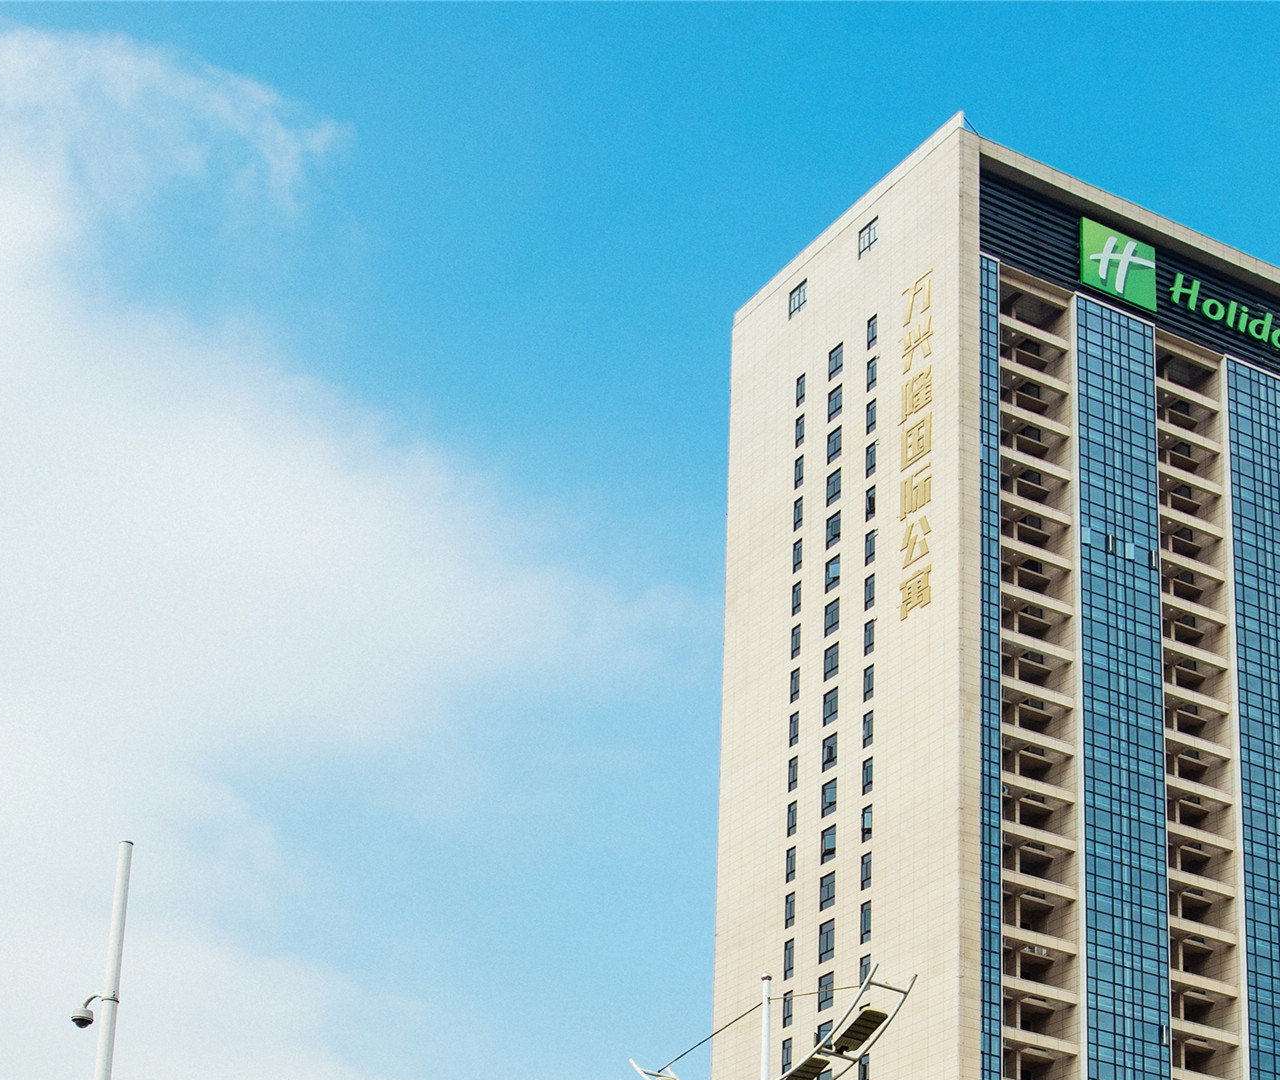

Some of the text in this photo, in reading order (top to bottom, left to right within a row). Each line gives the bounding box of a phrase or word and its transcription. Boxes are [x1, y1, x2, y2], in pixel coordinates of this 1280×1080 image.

[899, 267, 933, 622] 万兴隆国际公寓
